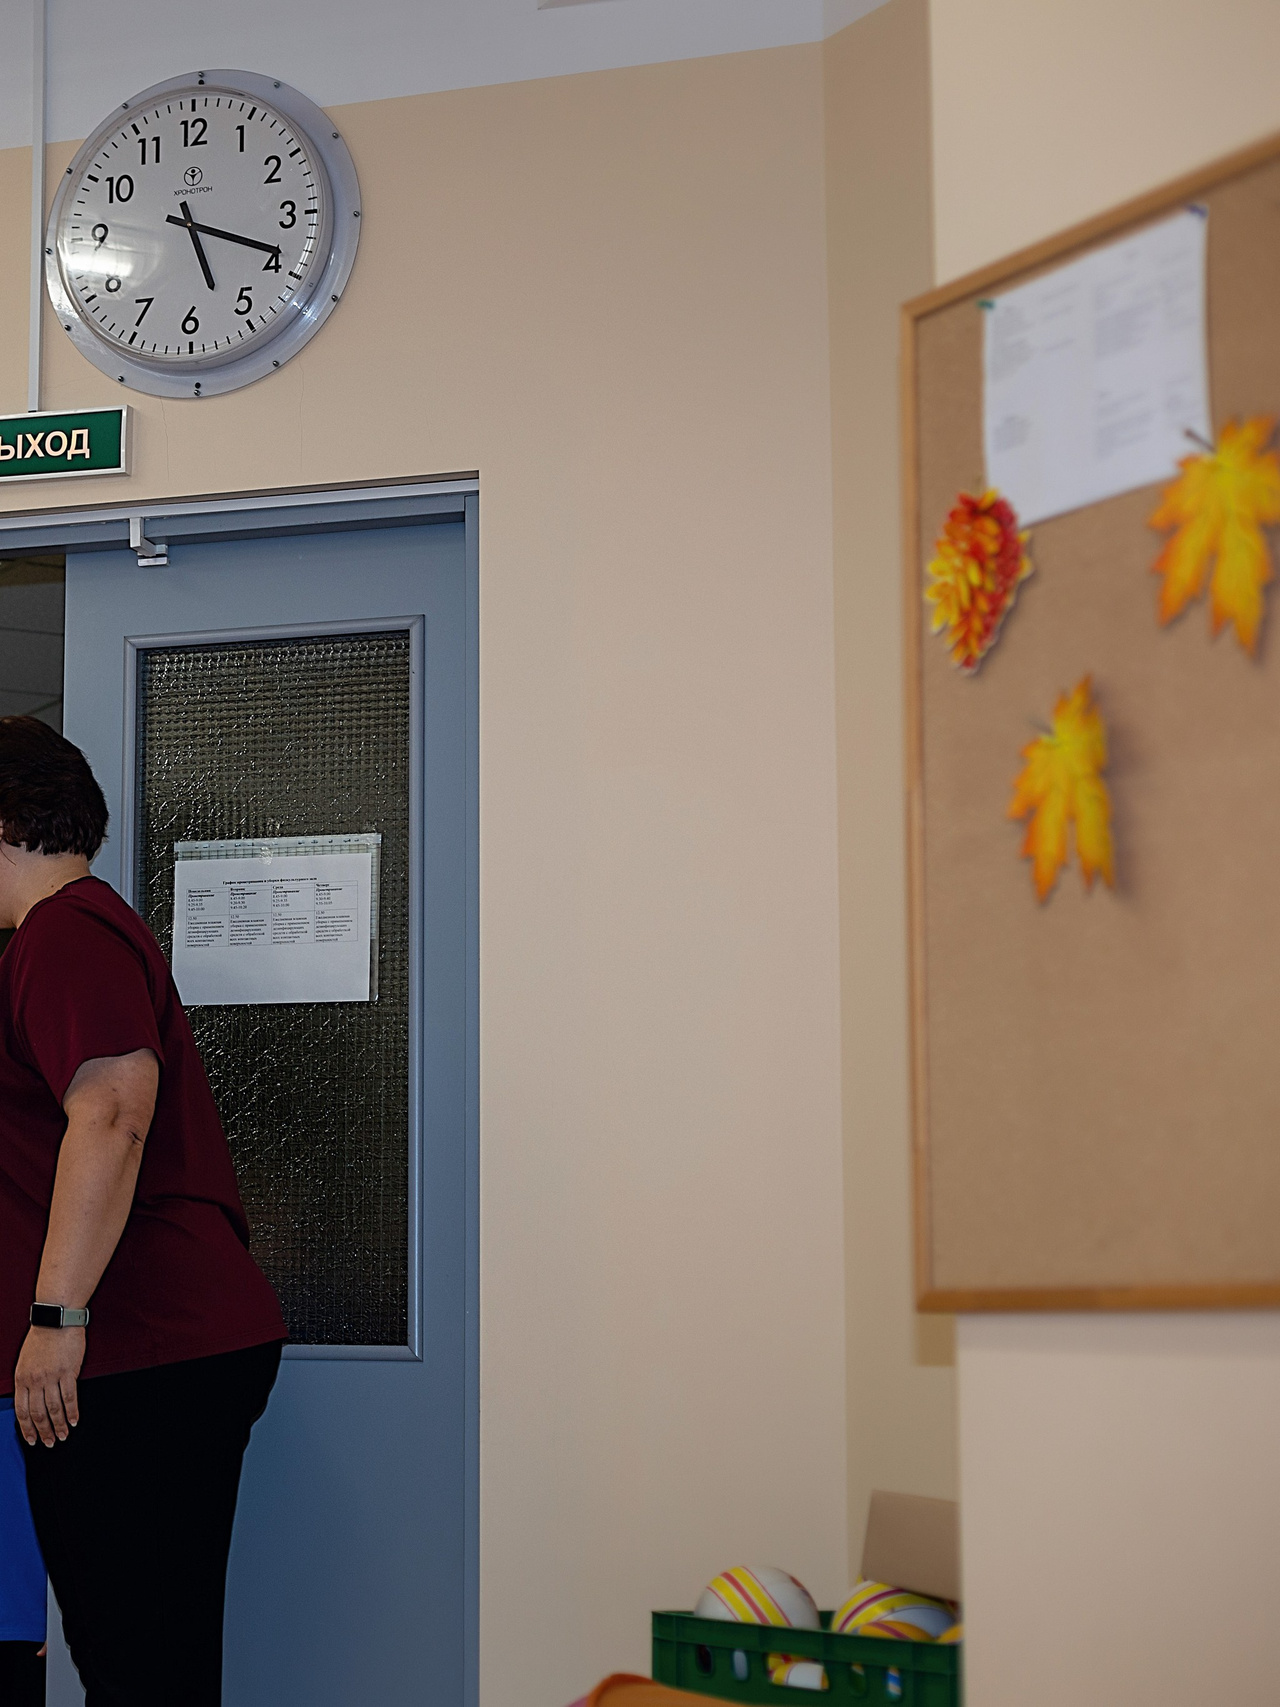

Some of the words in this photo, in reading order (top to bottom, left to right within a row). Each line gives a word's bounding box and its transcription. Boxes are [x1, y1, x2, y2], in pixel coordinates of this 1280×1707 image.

[180, 118, 208, 147] 12
[236, 125, 245, 152] 1
[138, 136, 161, 165] 11
[263, 155, 282, 184] 2
[105, 174, 134, 203] 10
[173, 186, 213, 197] ХРОНОТРОН
[278, 200, 296, 229] 3
[91, 223, 109, 251] 9
[261, 244, 282, 273] 4
[134, 297, 155, 327] 7
[234, 286, 253, 316] 5
[181, 305, 200, 335] 6
